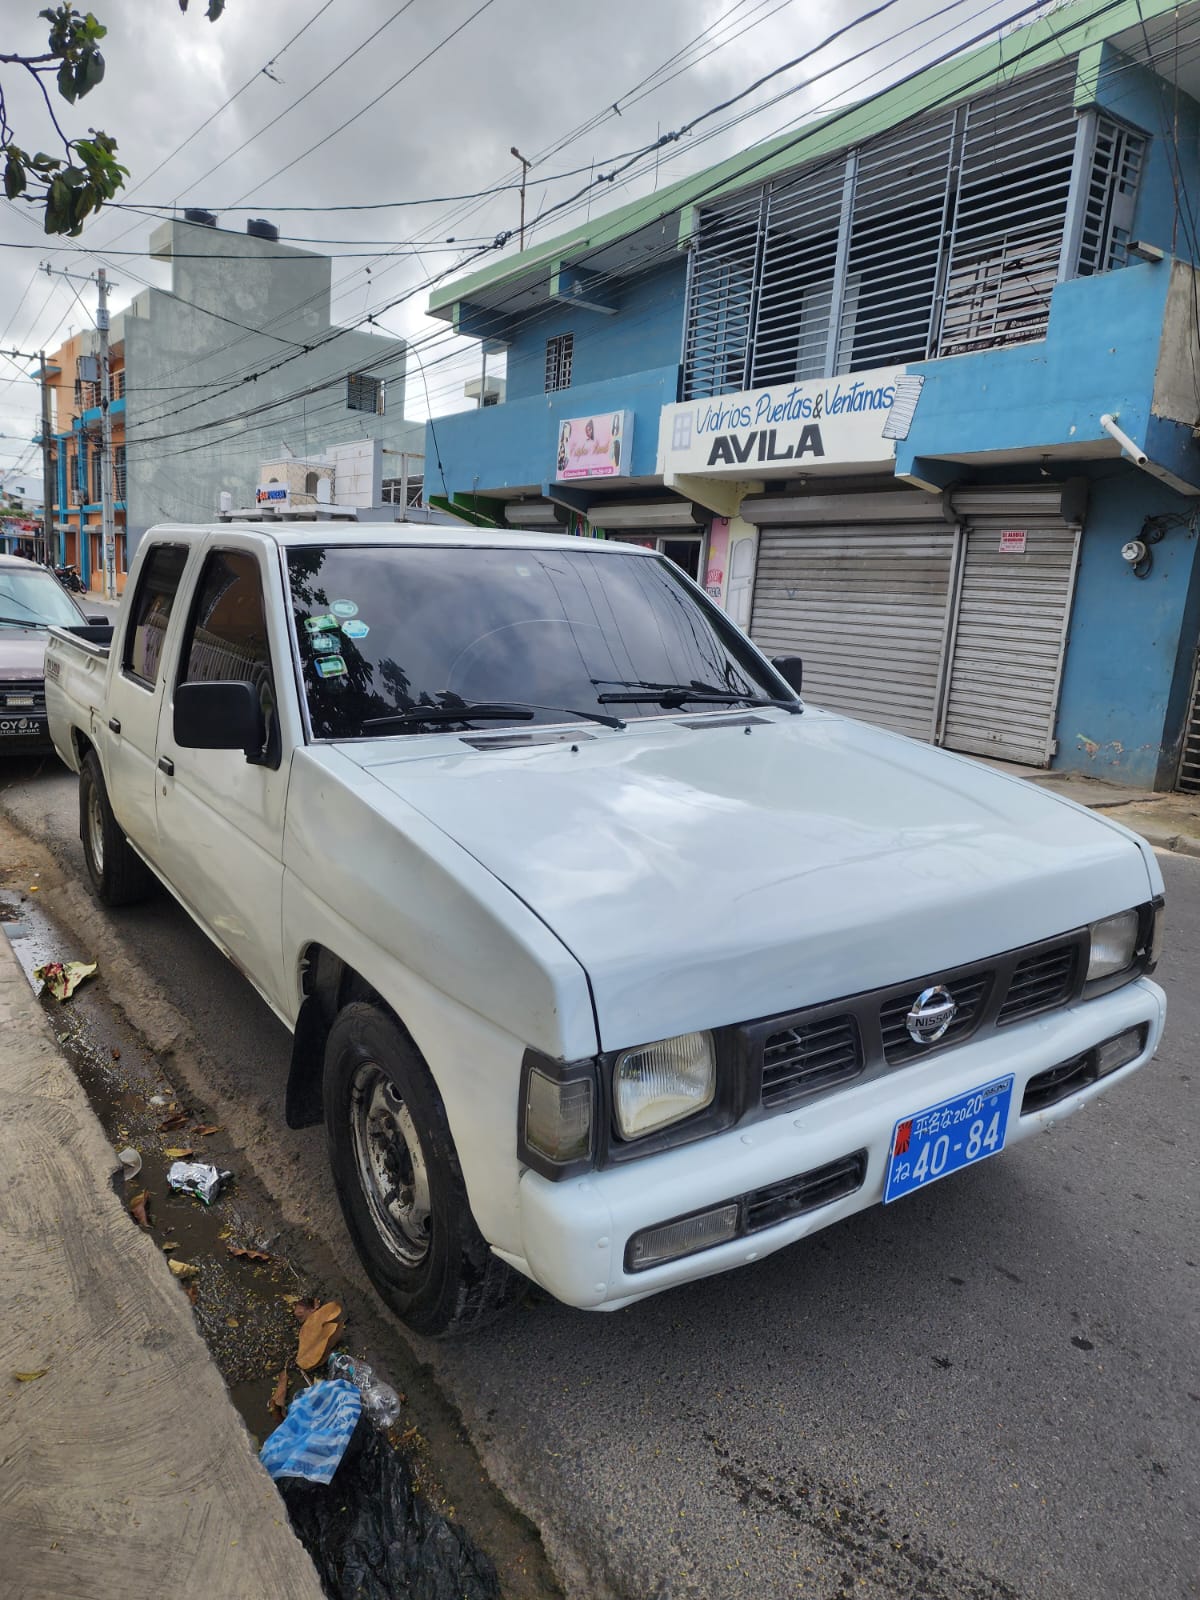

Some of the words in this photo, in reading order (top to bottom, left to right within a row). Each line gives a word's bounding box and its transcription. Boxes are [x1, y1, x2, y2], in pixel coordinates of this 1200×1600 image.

[755, 386, 812, 425] Puertas
[812, 393, 823, 420] &
[825, 381, 896, 415] Ventanas
[707, 423, 825, 466] AVILA
[915, 1006, 958, 1027] NISSAN
[912, 1111, 1001, 1182] 40-84
